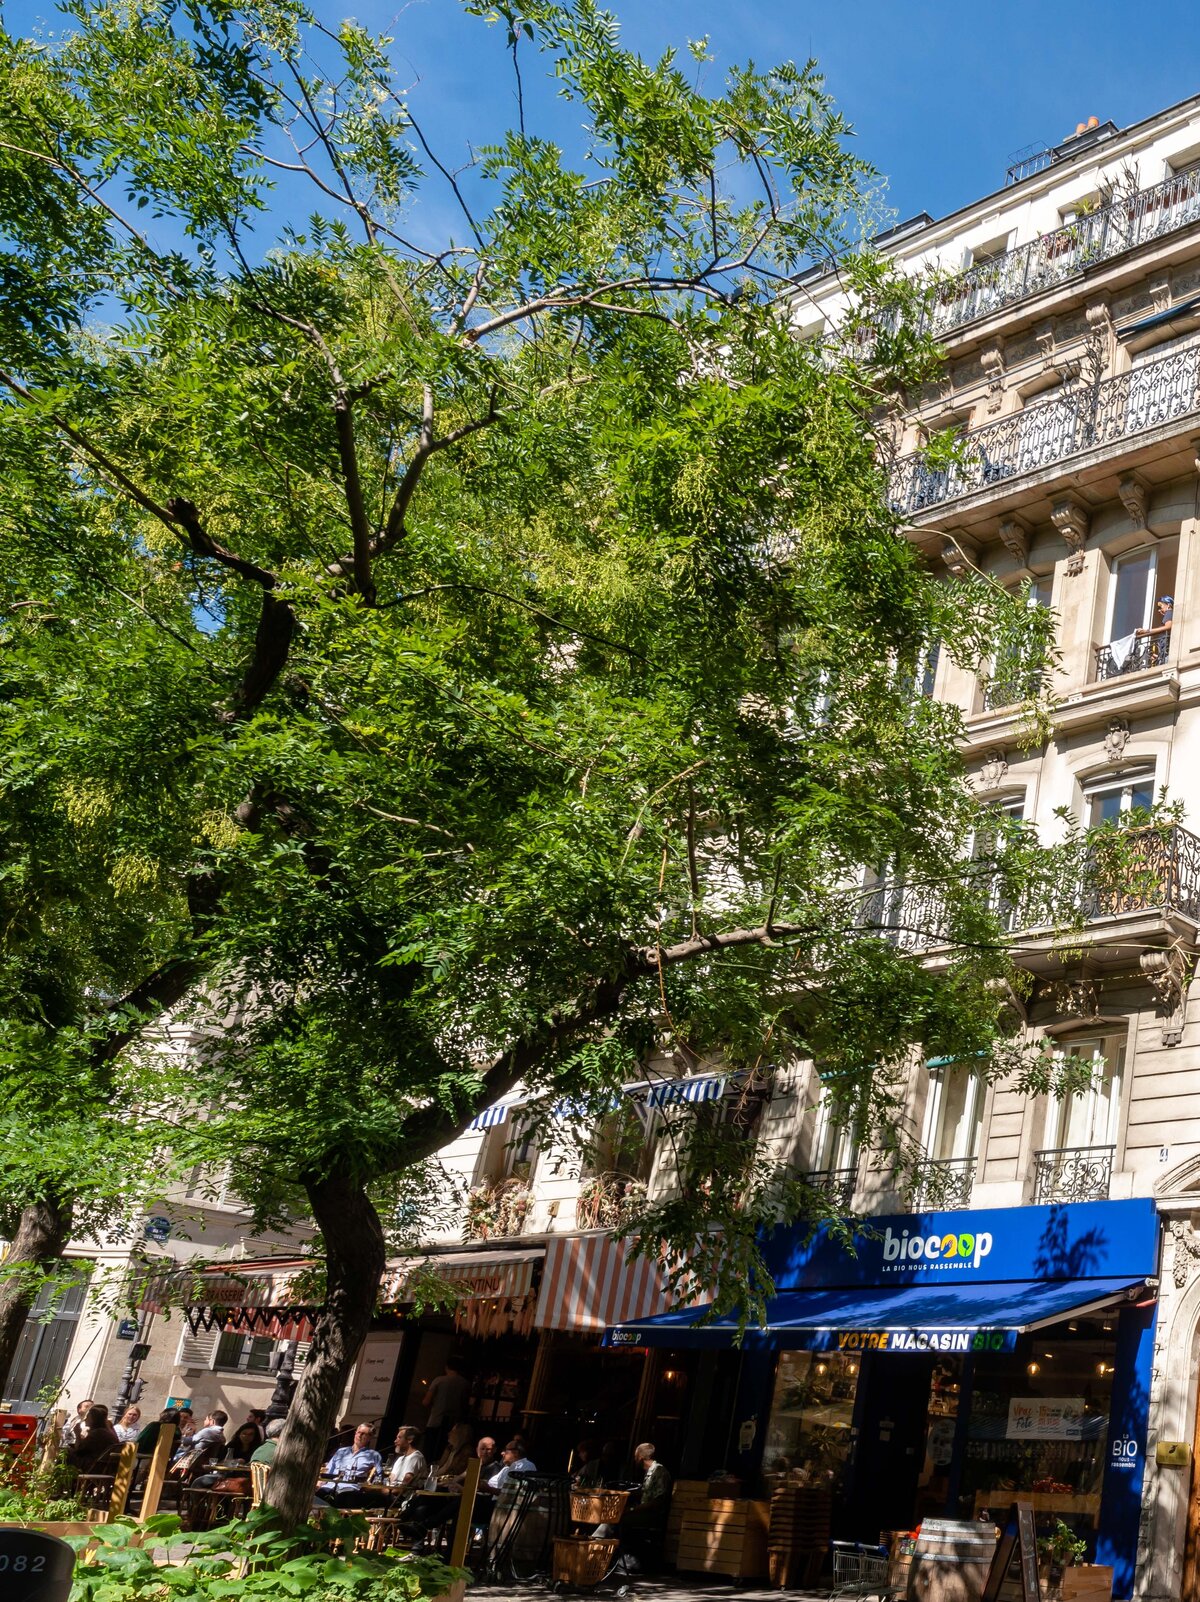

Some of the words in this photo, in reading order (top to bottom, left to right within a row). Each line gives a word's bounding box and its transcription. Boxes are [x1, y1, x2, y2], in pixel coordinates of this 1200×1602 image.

[883, 1227, 993, 1268] biocoop
[930, 1262, 972, 1270] RASSEMBLE
[838, 1333, 889, 1349] VOTRE
[891, 1333, 969, 1350] MAGASIN
[973, 1333, 1004, 1349] BIO
